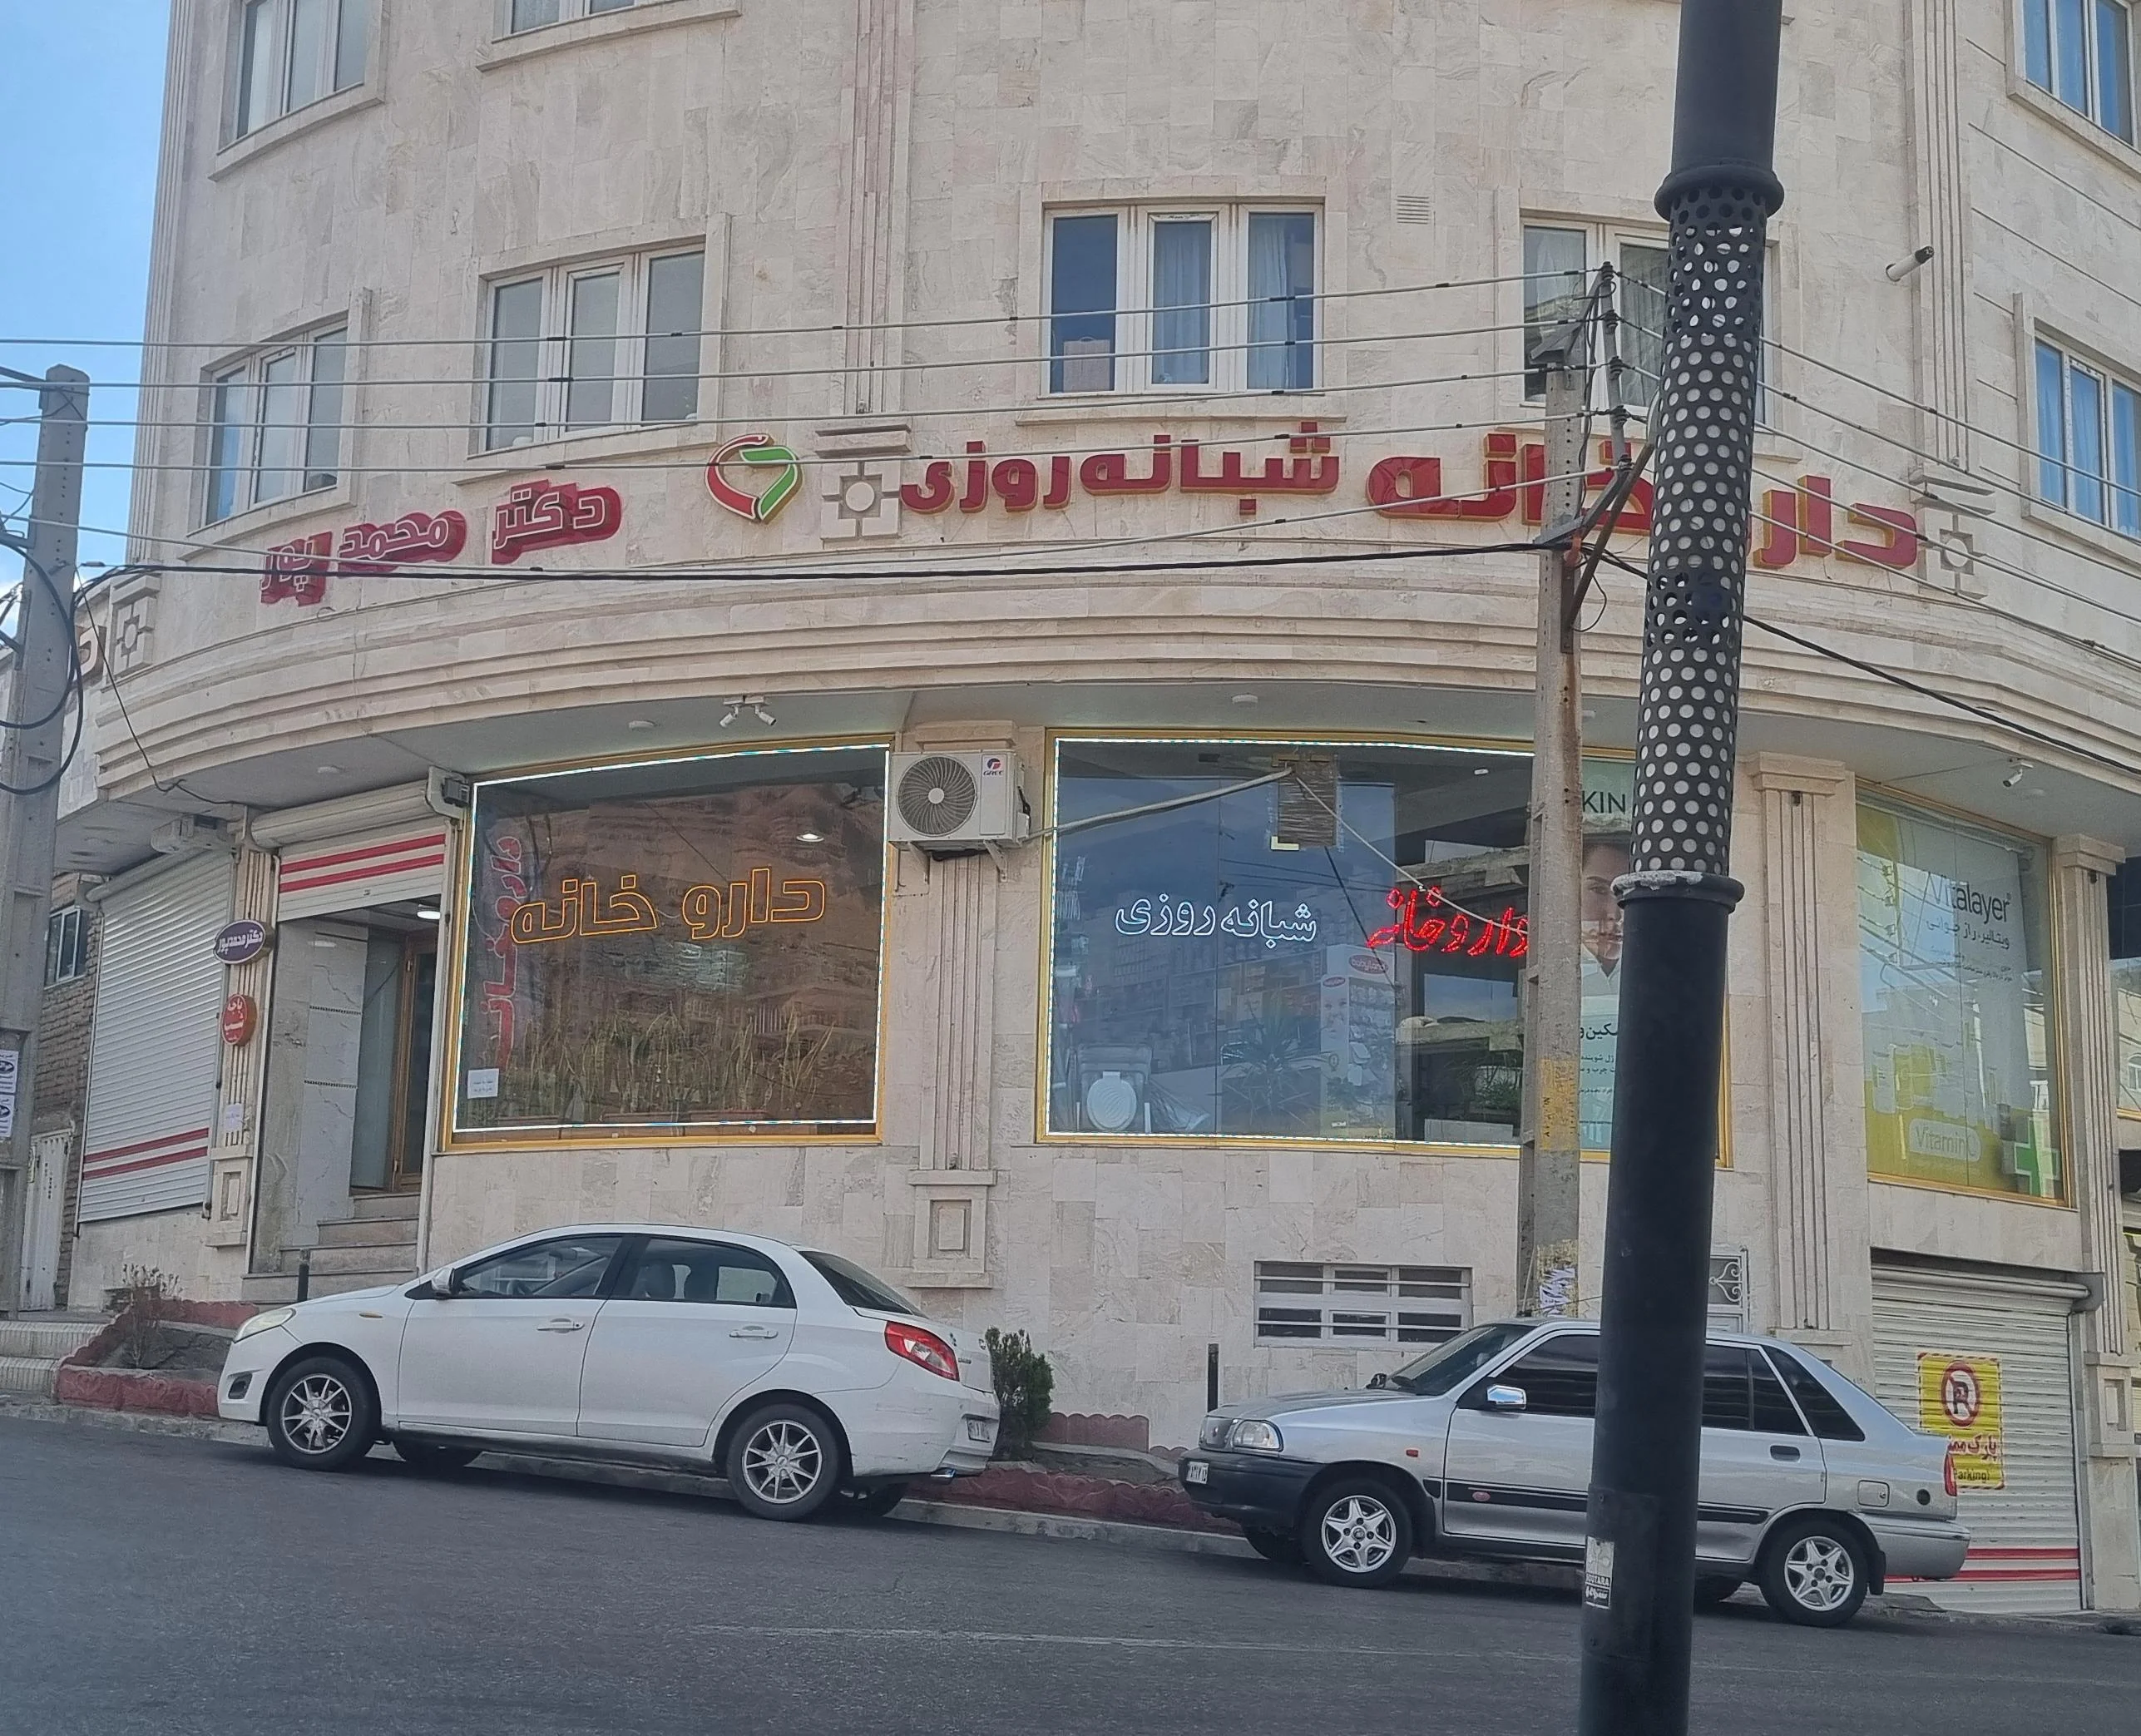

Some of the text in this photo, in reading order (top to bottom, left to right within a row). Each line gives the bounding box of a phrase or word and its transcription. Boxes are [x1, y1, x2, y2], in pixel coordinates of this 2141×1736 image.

[900, 421, 1340, 516] شبانه روزی
[260, 479, 623, 606] دکتر محمد پور
[1748, 474, 1918, 570] دار
[1581, 790, 1625, 815] KIN
[511, 868, 825, 944] دارو خانه
[1115, 893, 1317, 949] شبانه روزی
[1585, 1022, 1618, 1040] کین
